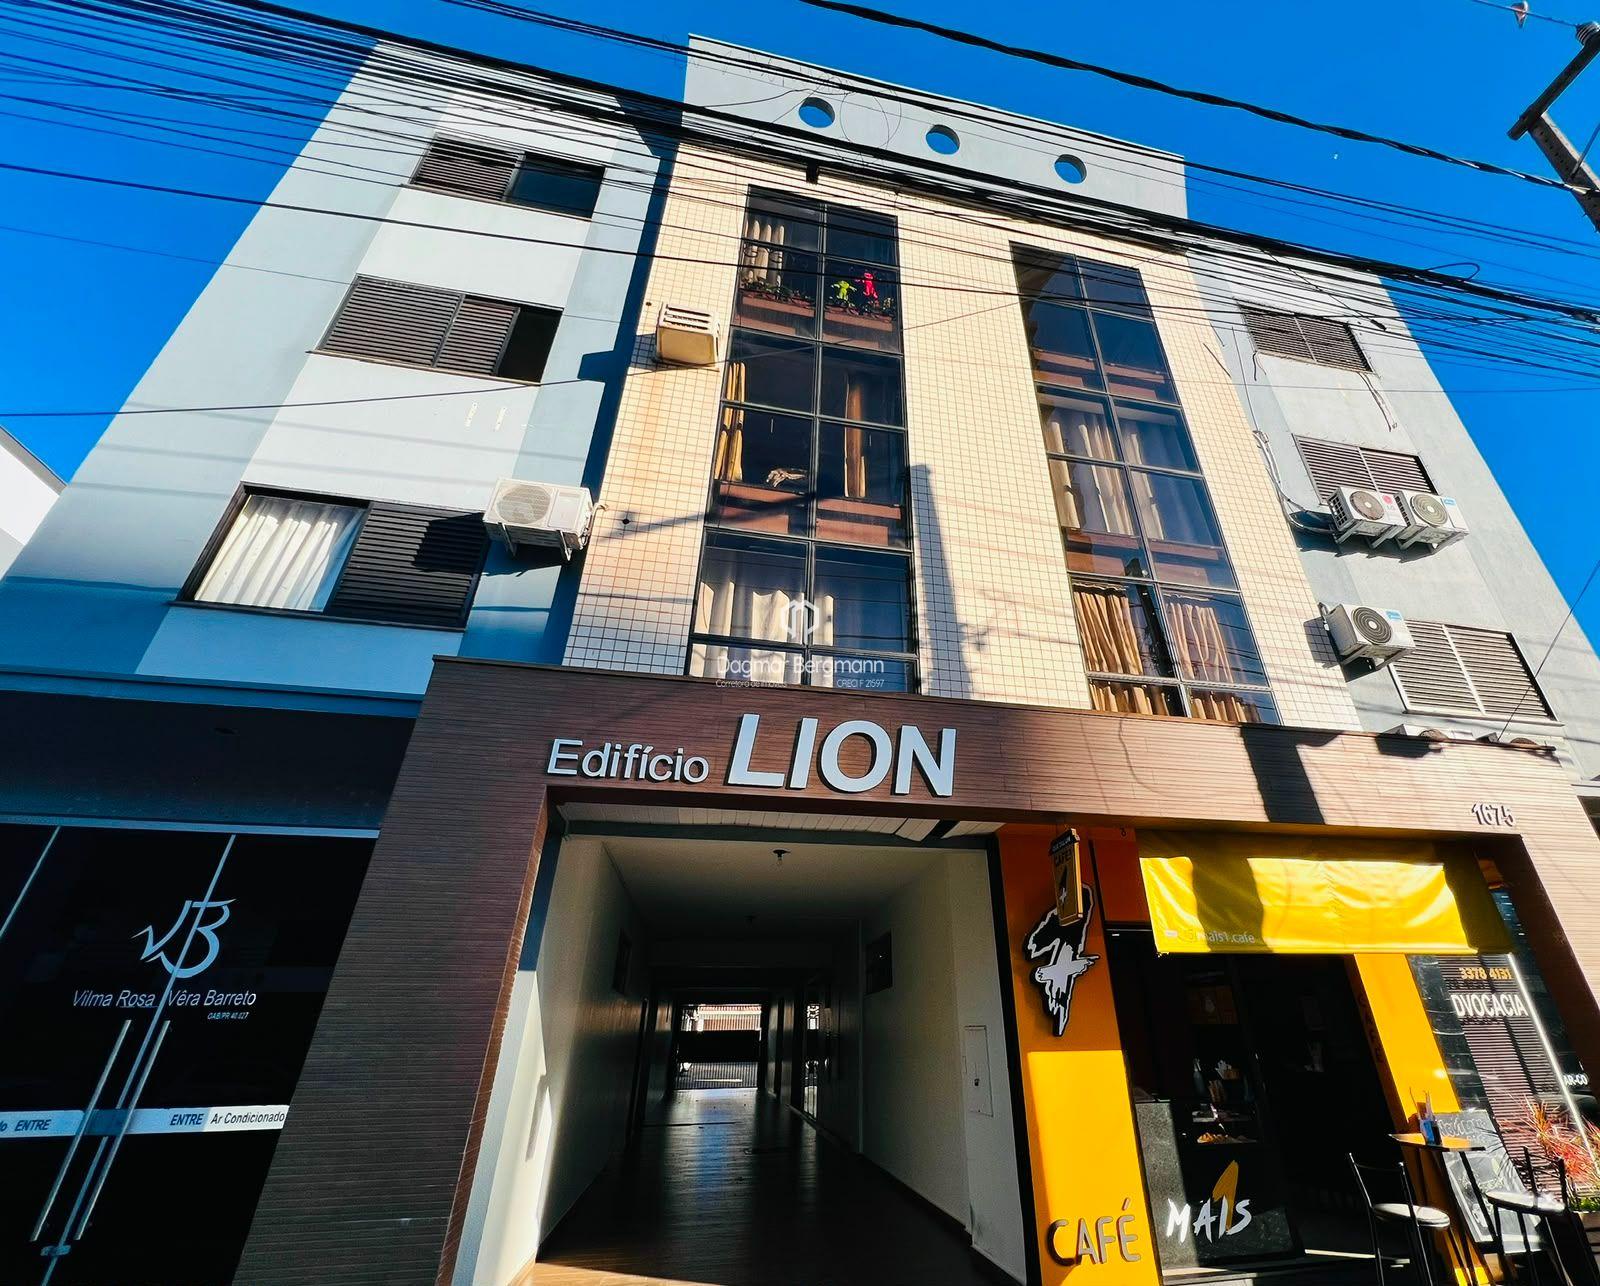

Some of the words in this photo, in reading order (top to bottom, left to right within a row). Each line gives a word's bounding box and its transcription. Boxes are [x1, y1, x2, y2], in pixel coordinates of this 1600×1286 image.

[546, 737, 710, 784] Edifício
[727, 713, 957, 797] LION
[1471, 801, 1514, 828] 1675
[1459, 966, 1487, 980] 3378
[1489, 967, 1512, 980] 4131
[72, 989, 113, 1007] Vilma
[116, 989, 156, 1007] Rosa
[203, 989, 257, 1006] Barreto
[1450, 993, 1529, 1016] DVOCACIA
[14, 1119, 52, 1131] ENTRE
[170, 1113, 204, 1126] ENTRE
[210, 1113, 222, 1124] Ar
[223, 1111, 285, 1125] Condicionado
[1048, 1197, 1142, 1267] CAFÉ
